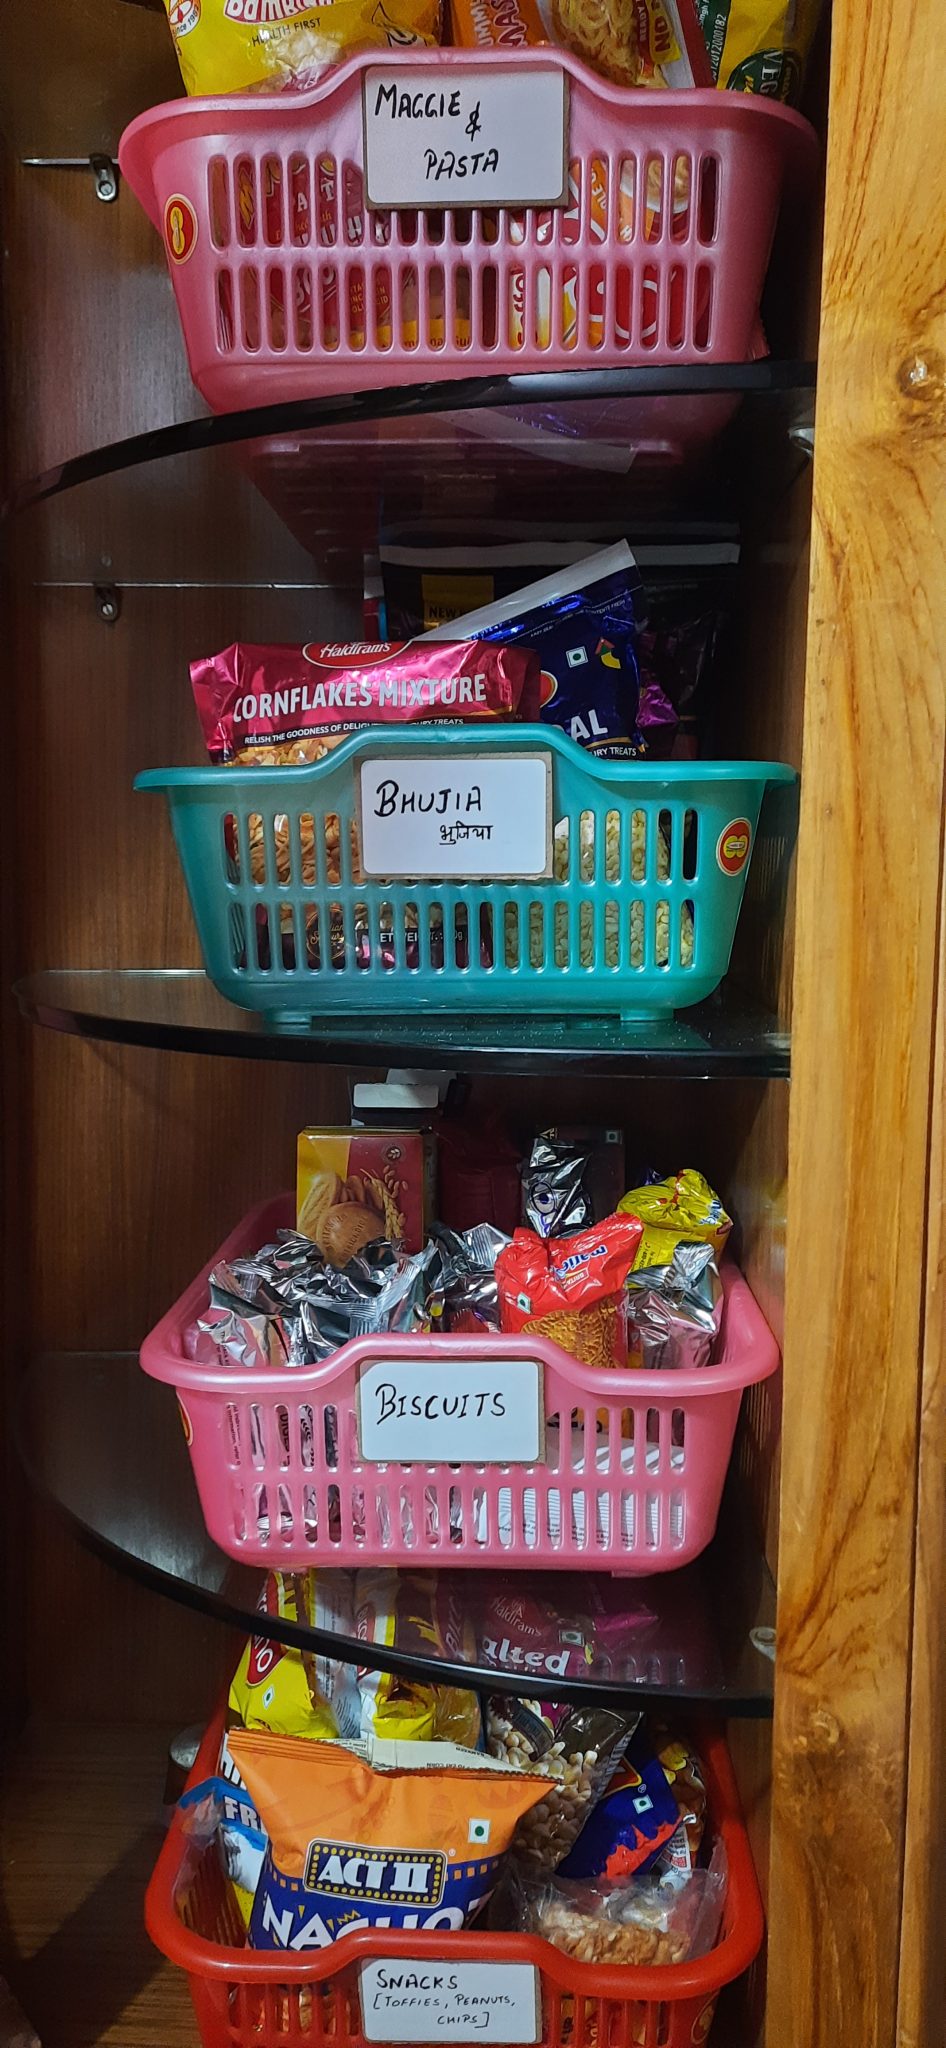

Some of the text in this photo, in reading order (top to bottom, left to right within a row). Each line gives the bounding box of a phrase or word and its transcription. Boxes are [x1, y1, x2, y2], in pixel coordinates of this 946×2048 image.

[294, 18, 321, 31] FIRST
[375, 84, 461, 119] MAGGIE
[424, 149, 499, 180] PASTA
[233, 674, 487, 723] CORNFLAKES MIXTURE
[244, 736, 272, 745] RELISH
[272, 733, 286, 742] THE
[286, 726, 330, 739] GOODNESS
[331, 724, 343, 732] OF
[608, 747, 637, 757] TREATS
[374, 780, 481, 817] BHUJIA
[375, 1383, 505, 1425] BISCUITS
[482, 1636, 571, 1677] alted
[317, 1855, 432, 1894] ACT II
[376, 1969, 459, 1990] SNACKS
